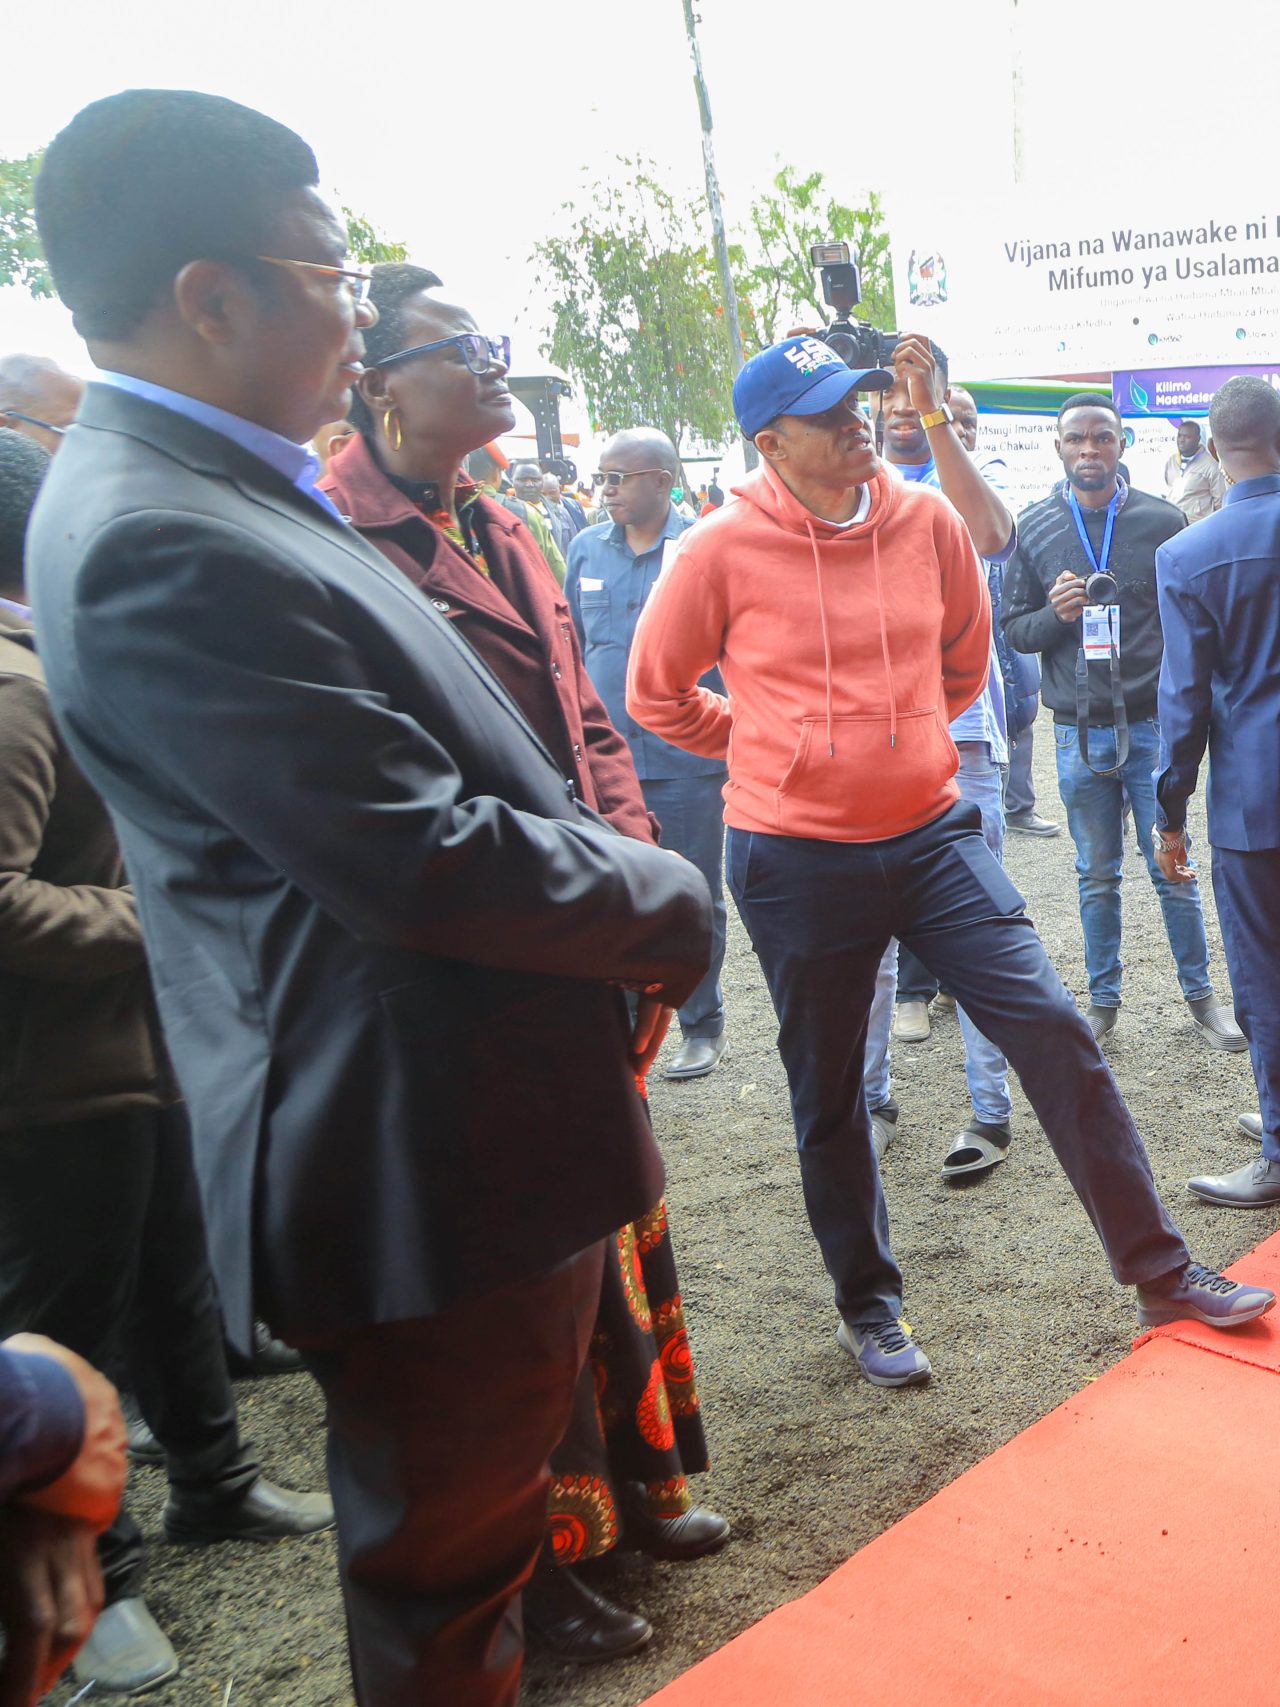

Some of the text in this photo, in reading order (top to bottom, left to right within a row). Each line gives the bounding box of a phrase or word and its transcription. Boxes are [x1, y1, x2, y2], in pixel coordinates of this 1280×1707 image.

[1004, 239, 1072, 268] Vijana
[1078, 238, 1105, 257] na
[1111, 219, 1238, 253] Wanawake
[1245, 215, 1267, 241] ni
[1048, 266, 1134, 291] Mifumo
[1141, 264, 1167, 290] ya
[1175, 252, 1280, 280] Usalama
[1155, 380, 1192, 394] Kilimo
[1015, 423, 1043, 435] Imara
